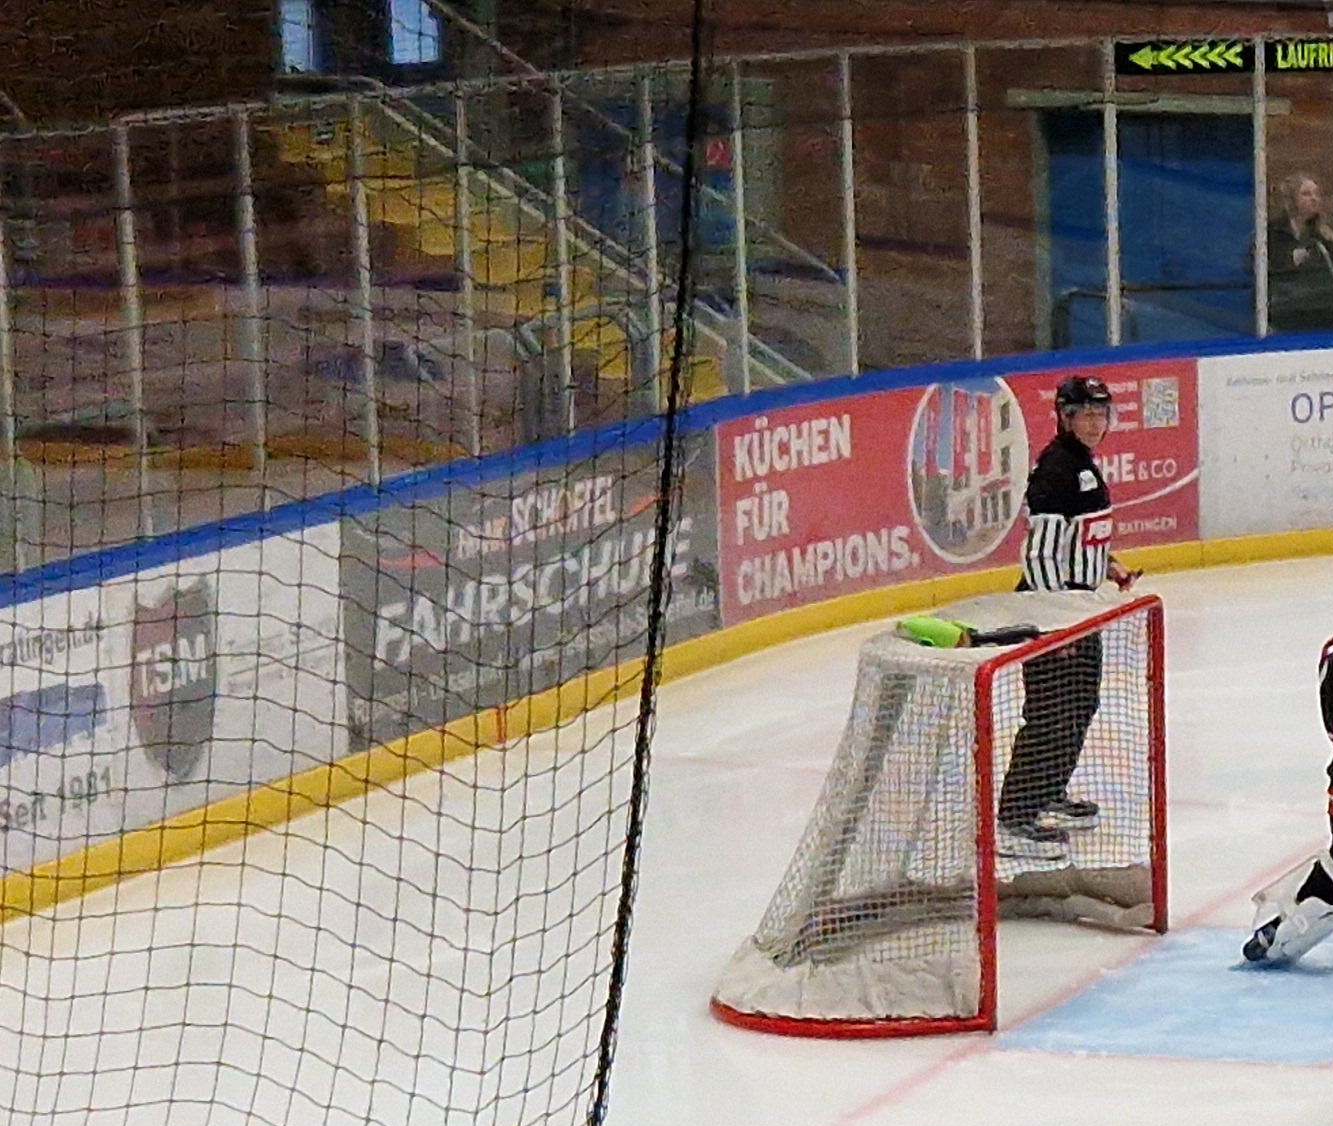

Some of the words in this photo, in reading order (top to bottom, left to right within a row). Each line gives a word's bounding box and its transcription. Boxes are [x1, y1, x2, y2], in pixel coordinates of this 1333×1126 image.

[733, 412, 852, 483] KÜCHEN
[735, 486, 790, 547] FÜR
[737, 524, 922, 607] CHAMPIONS.
